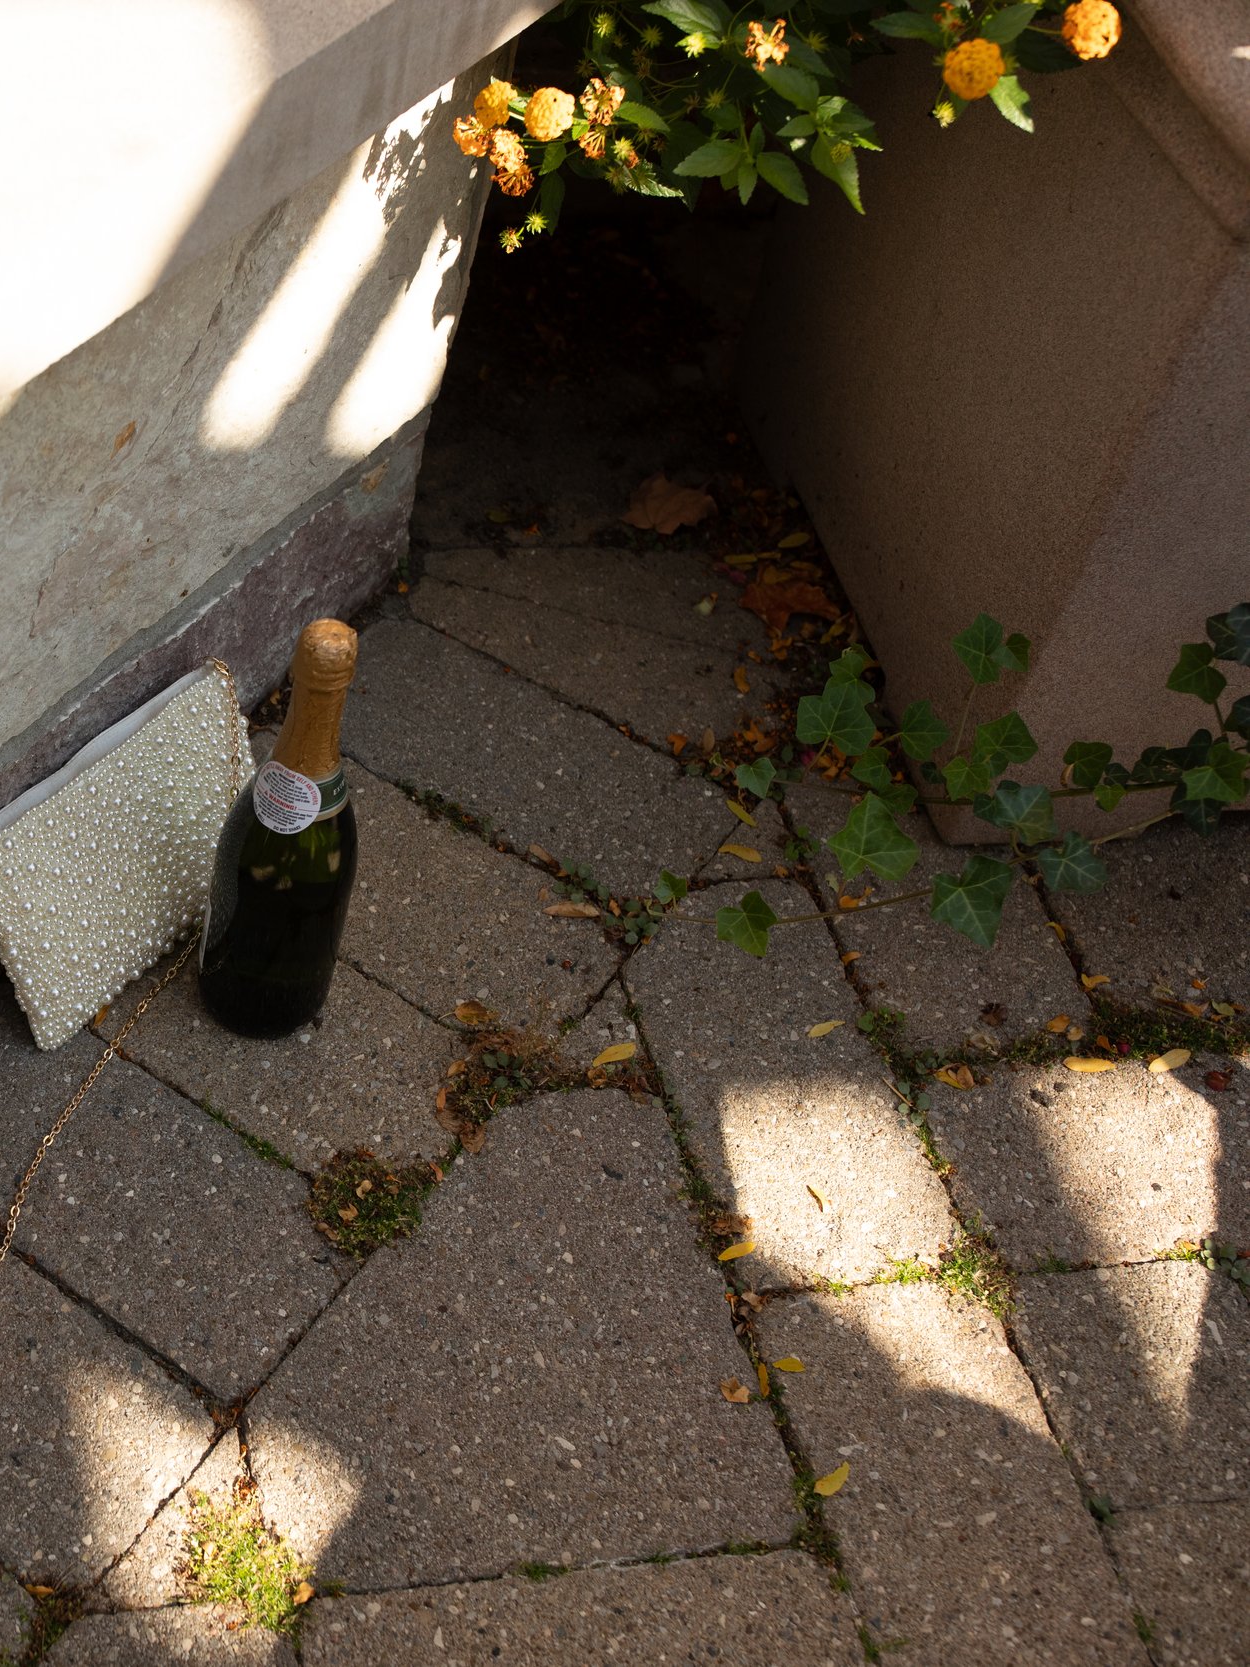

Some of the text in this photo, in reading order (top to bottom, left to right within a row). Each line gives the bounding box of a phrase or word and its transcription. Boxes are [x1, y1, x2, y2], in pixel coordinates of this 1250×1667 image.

[285, 770, 296, 779] FROM
[296, 775, 307, 785] SELF
[306, 783, 314, 792] AND
[268, 793, 298, 811] WARNING!
